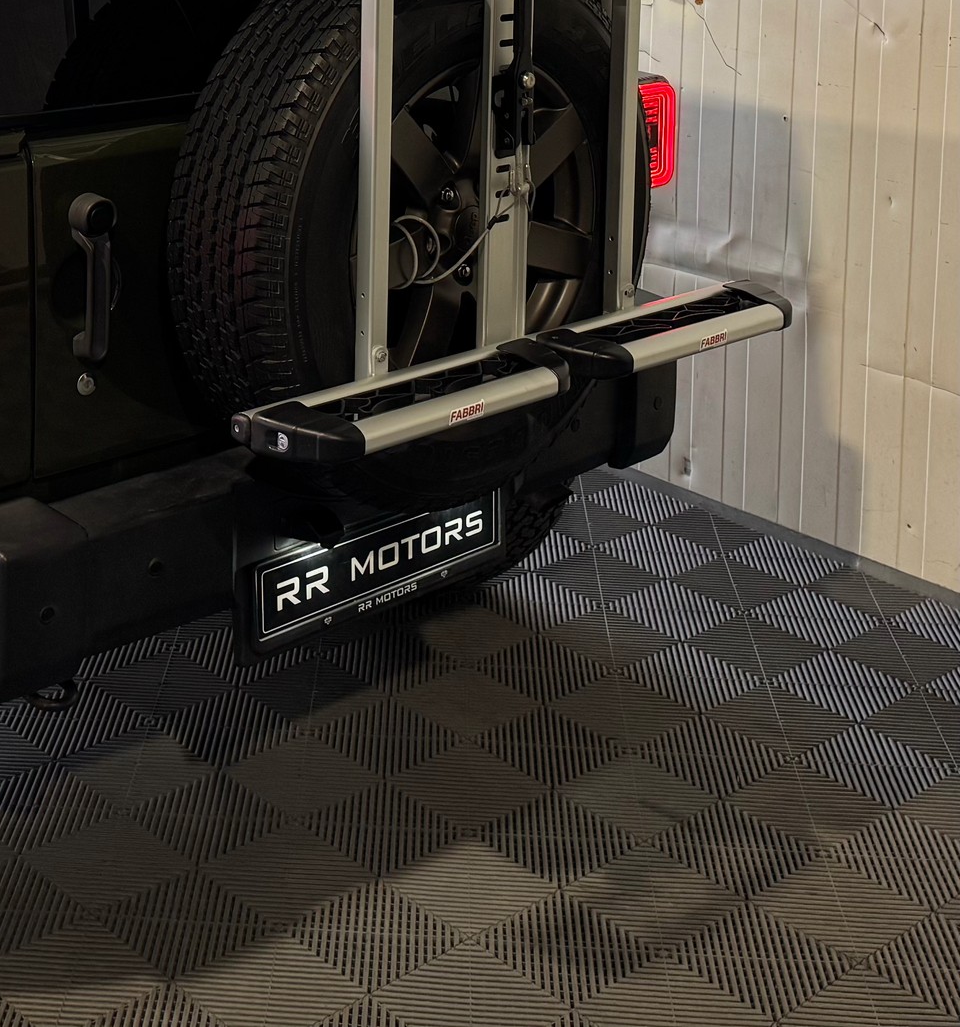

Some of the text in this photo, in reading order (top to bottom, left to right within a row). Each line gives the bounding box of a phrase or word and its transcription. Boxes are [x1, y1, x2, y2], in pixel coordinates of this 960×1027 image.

[700, 331, 727, 349] FABBRI
[450, 401, 484, 423] FABBRI
[276, 509, 483, 612] RR MOTORS
[357, 581, 418, 613] RR MOTORS
